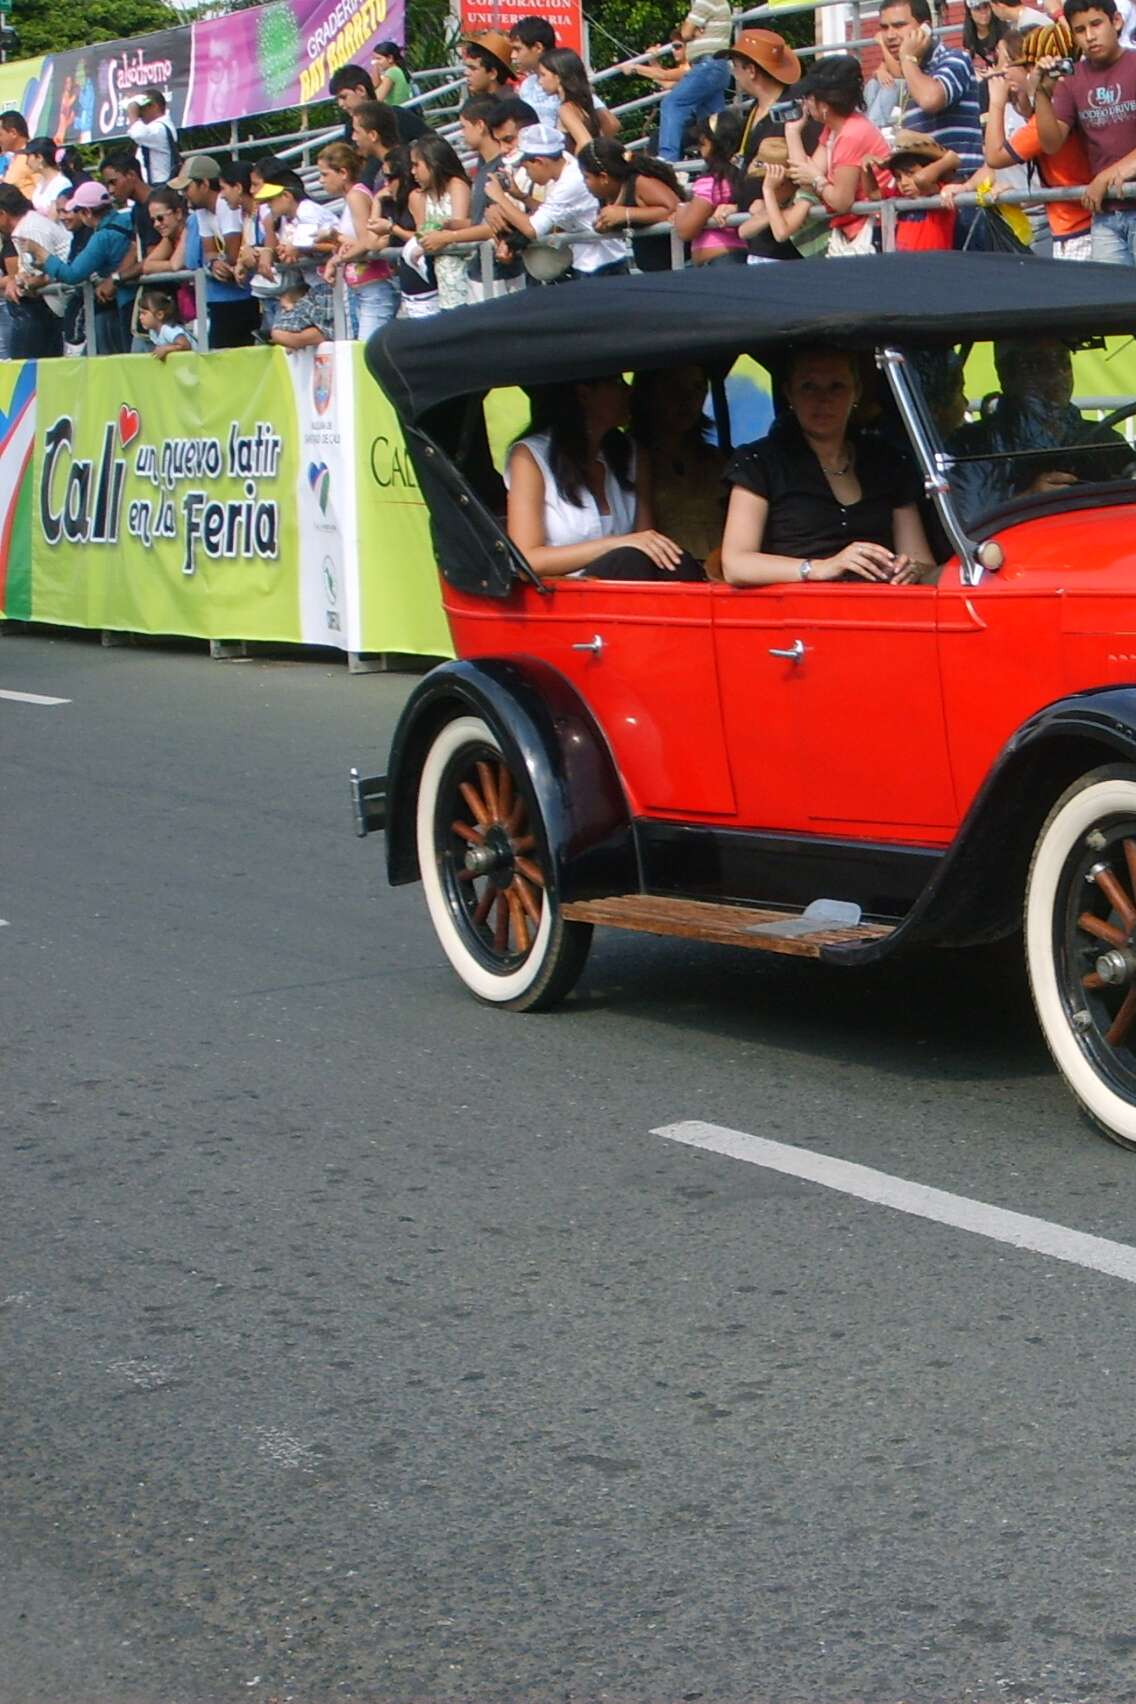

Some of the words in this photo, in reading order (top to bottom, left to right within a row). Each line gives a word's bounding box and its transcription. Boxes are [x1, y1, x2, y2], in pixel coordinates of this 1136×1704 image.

[40, 413, 127, 545] Cali
[135, 444, 159, 485] un
[162, 437, 223, 489] nuevo
[227, 420, 281, 477] latir
[128, 500, 152, 547] en
[153, 486, 177, 538] la
[182, 480, 278, 574] Feria
